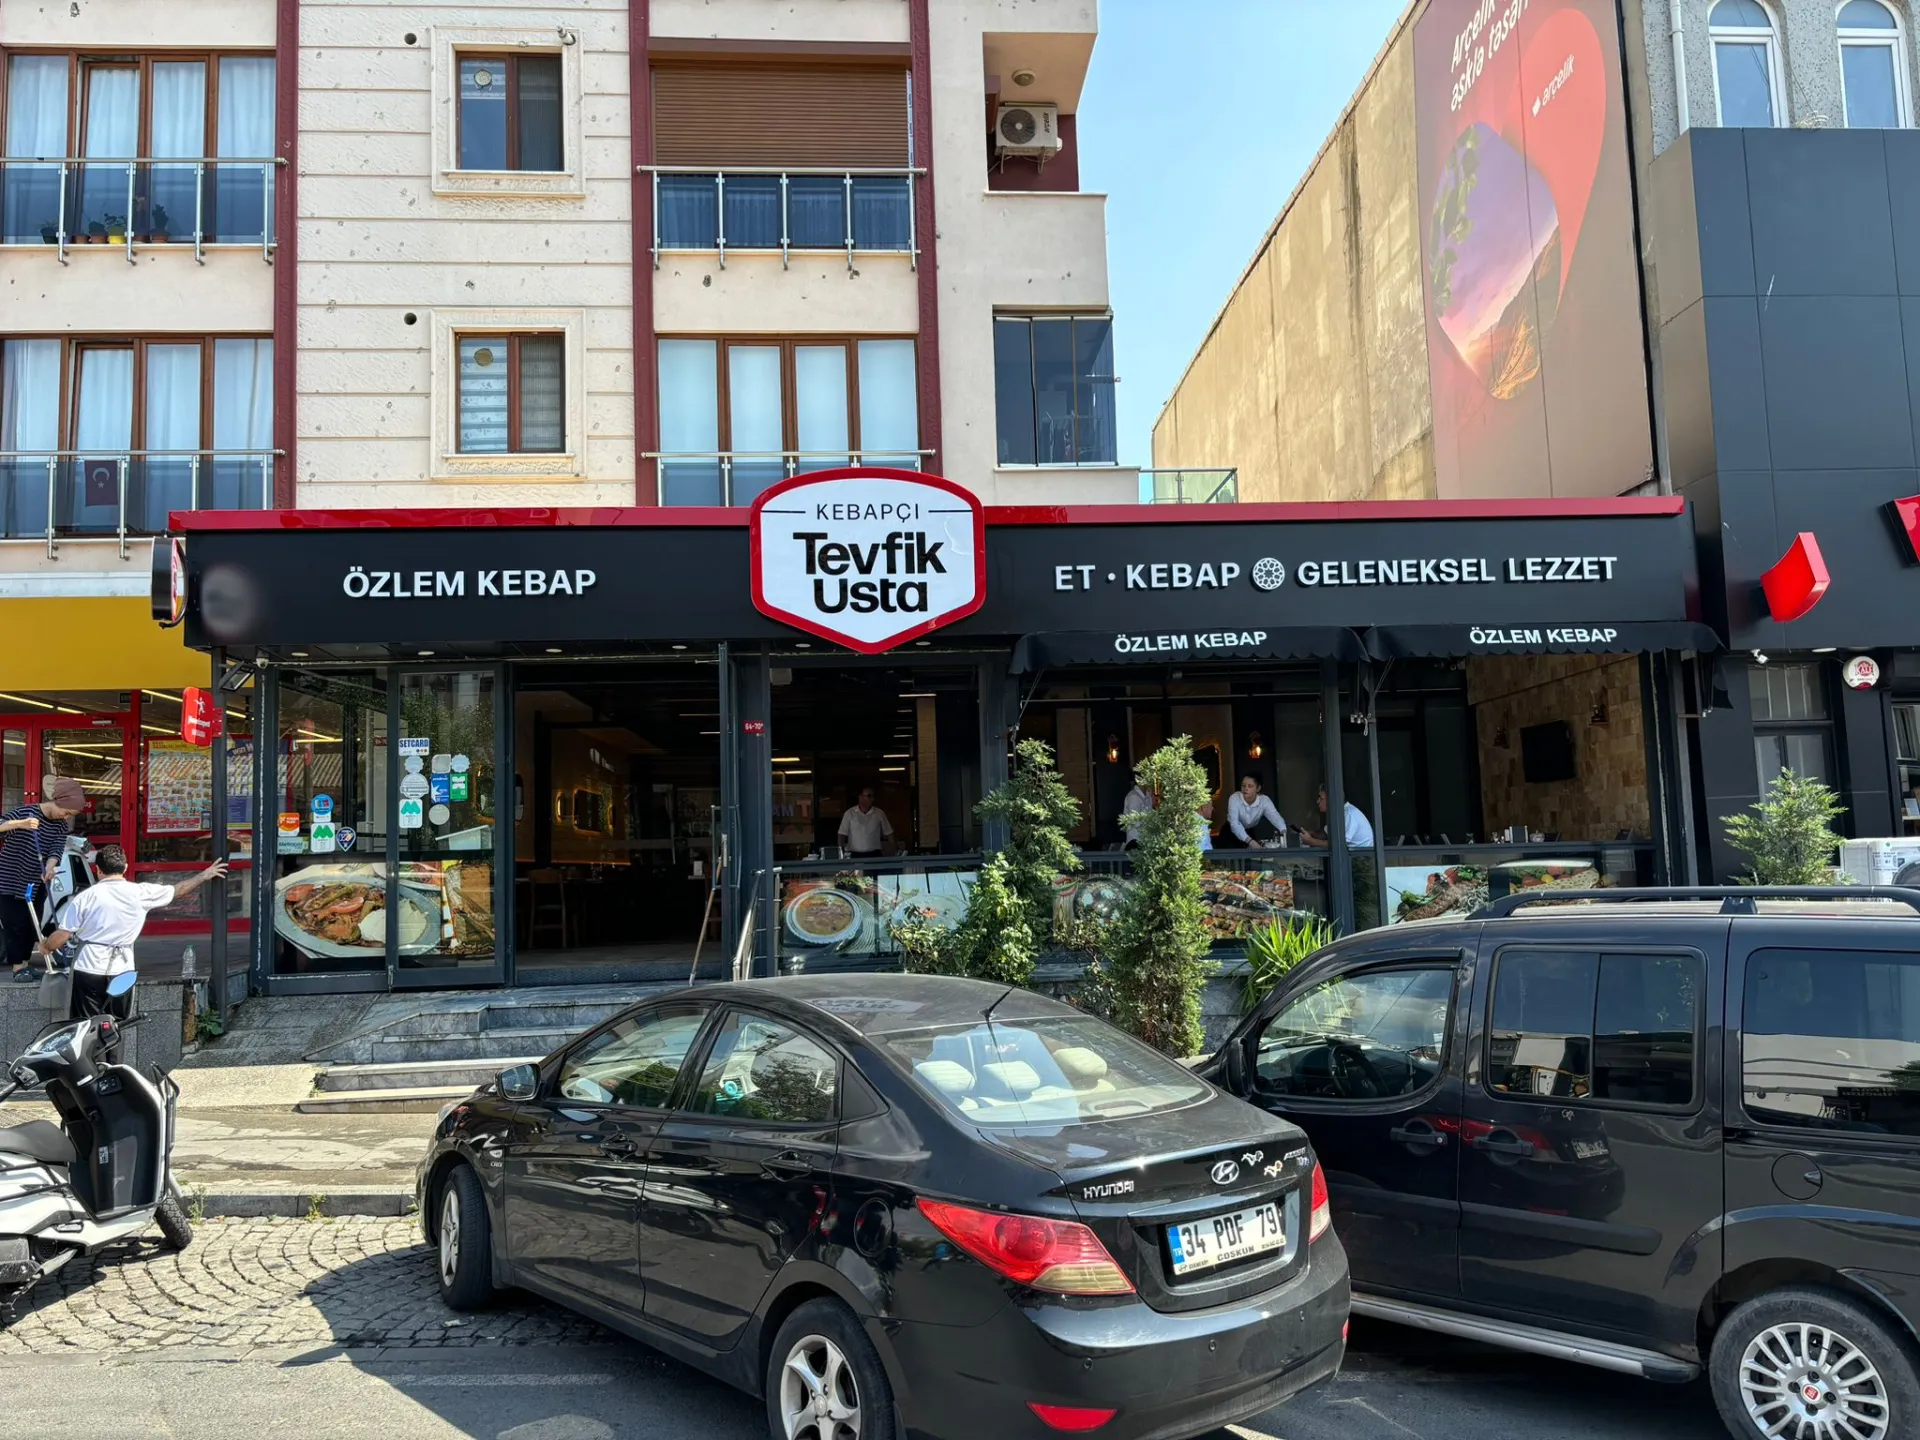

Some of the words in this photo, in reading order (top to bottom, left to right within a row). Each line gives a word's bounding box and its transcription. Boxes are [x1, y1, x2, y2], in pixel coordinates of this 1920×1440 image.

[1450, 46, 1484, 112] aşkla
[1542, 54, 1574, 106] arçelik
[817, 503, 919, 523] KEBAPÇI
[793, 532, 947, 575] Tevfik
[343, 566, 464, 597] ÖZLEM
[478, 569, 596, 596] KEBAP
[1055, 564, 1096, 590] ET
[1127, 562, 1240, 588] KEBAP
[1298, 558, 1496, 585] GELENEKSEL
[1508, 557, 1617, 580] LEZZET
[813, 578, 928, 613] Usta
[1115, 634, 1189, 653] ÖZLEM
[1196, 631, 1267, 649] KEBAP
[1469, 626, 1542, 644] ÖZLEM
[1546, 628, 1617, 643] KEBAP
[399, 739, 429, 748] SETCARD
[1083, 1180, 1134, 1199] HYUNDAI
[1182, 1224, 1206, 1257] 34
[1213, 1214, 1244, 1250] PDF
[1255, 1207, 1278, 1238] 79
